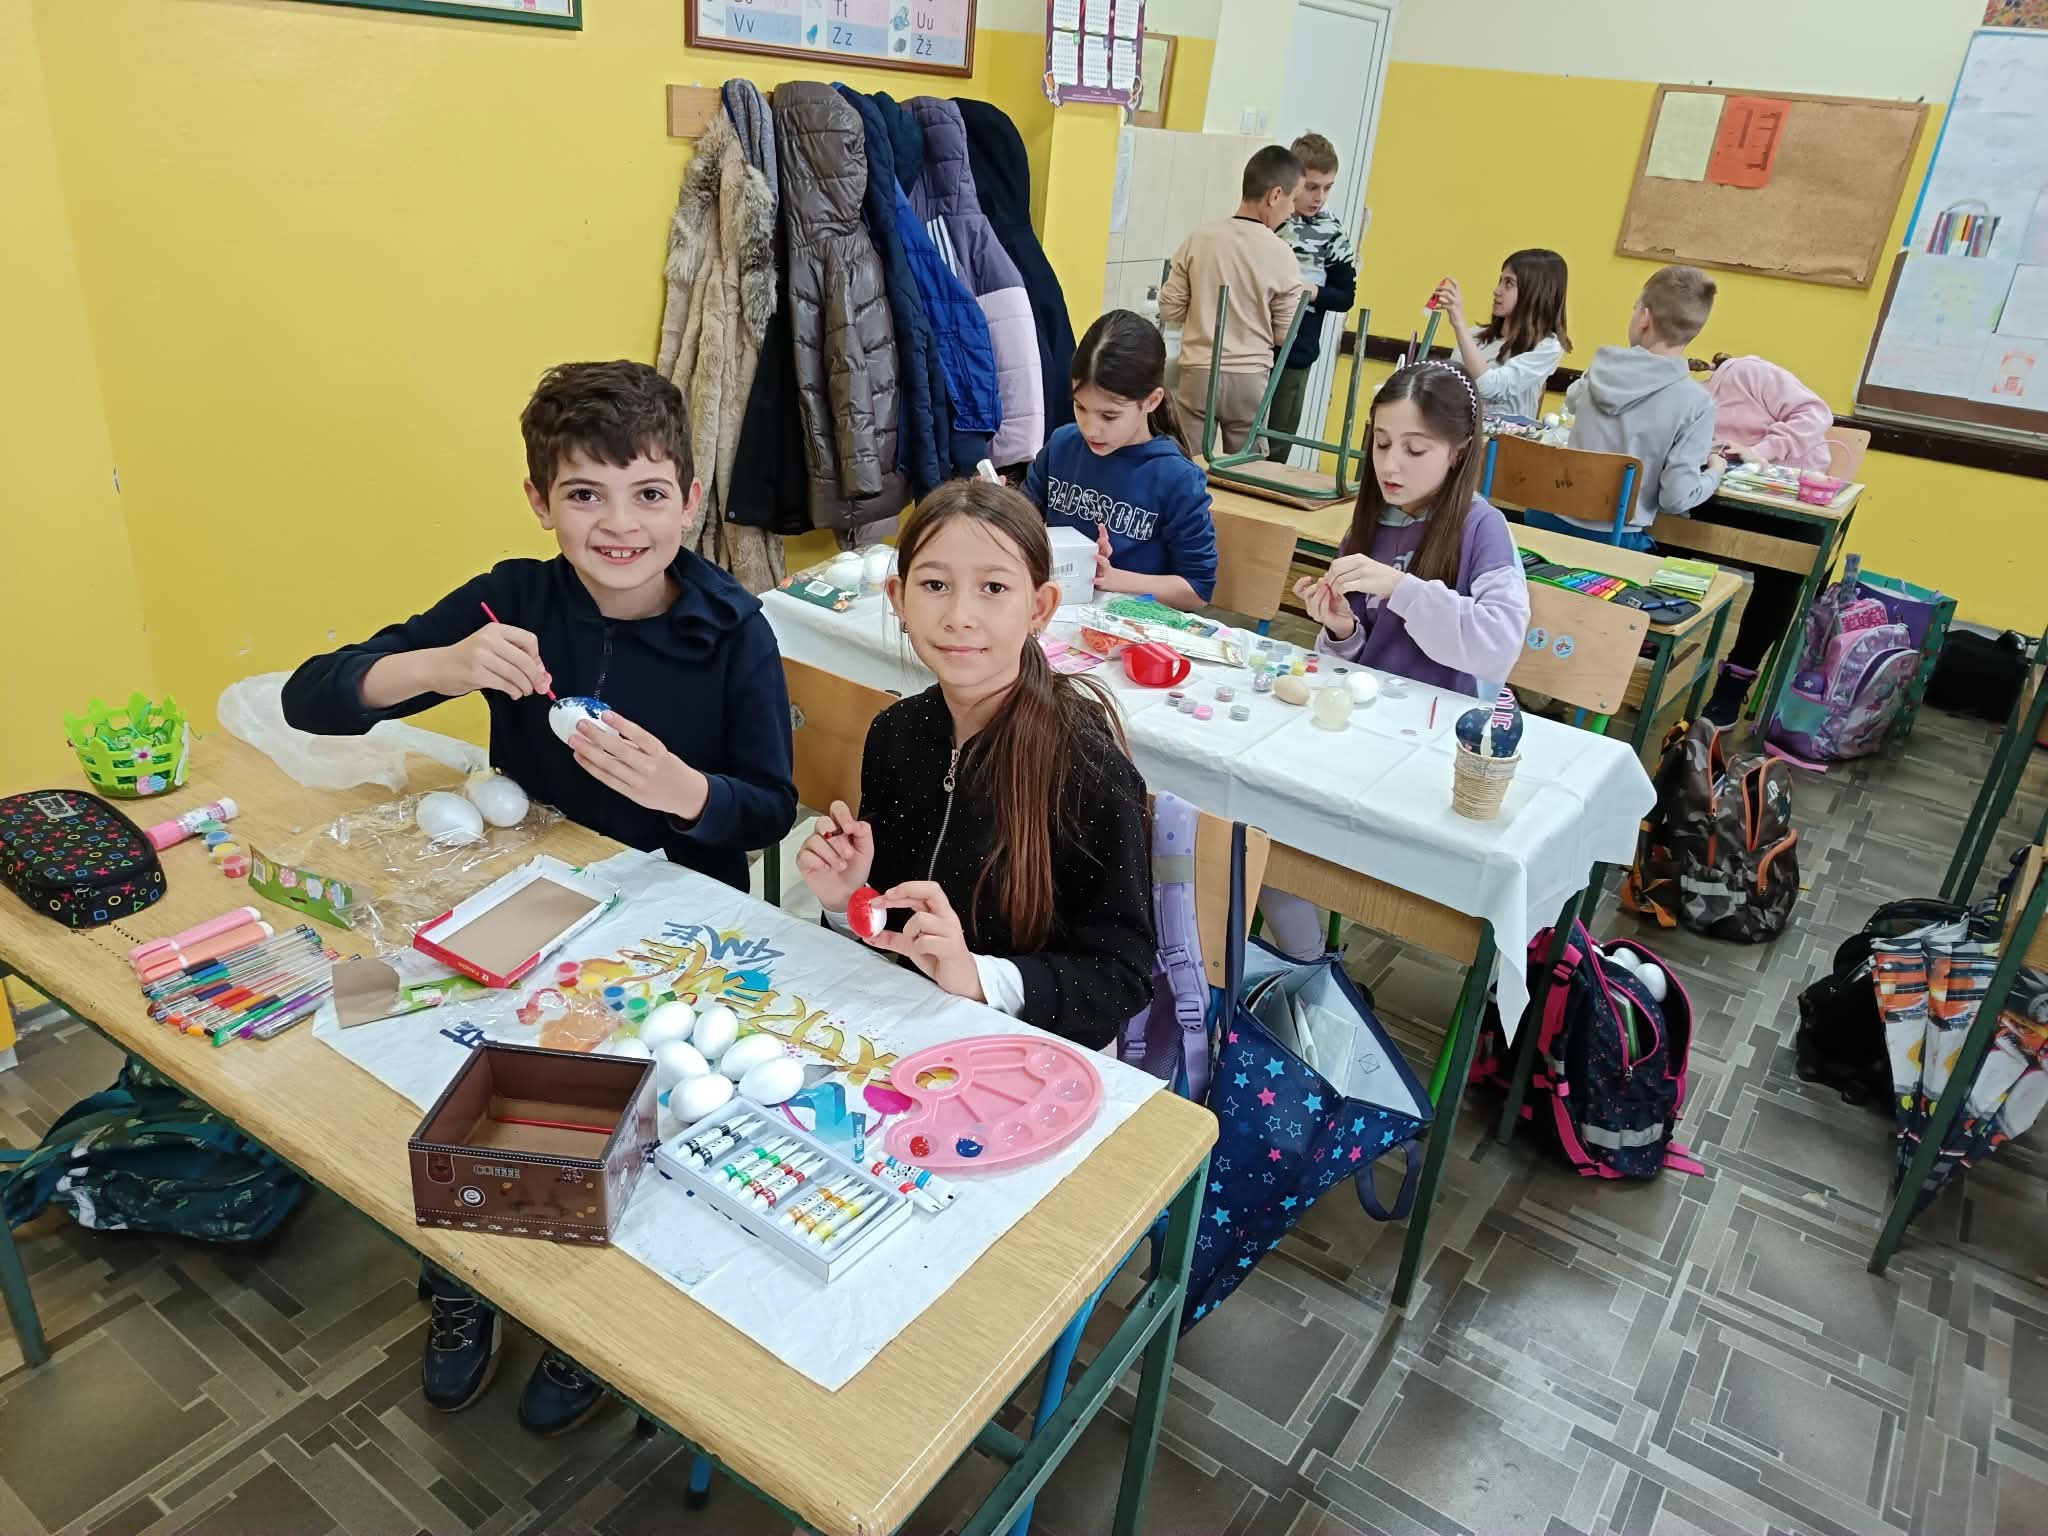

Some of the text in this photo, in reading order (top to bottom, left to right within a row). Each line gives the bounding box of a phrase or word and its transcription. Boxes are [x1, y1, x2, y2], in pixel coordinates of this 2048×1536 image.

[733, 12, 756, 33] Vv
[917, 11, 935, 31] Uu
[915, 34, 934, 56] Žž
